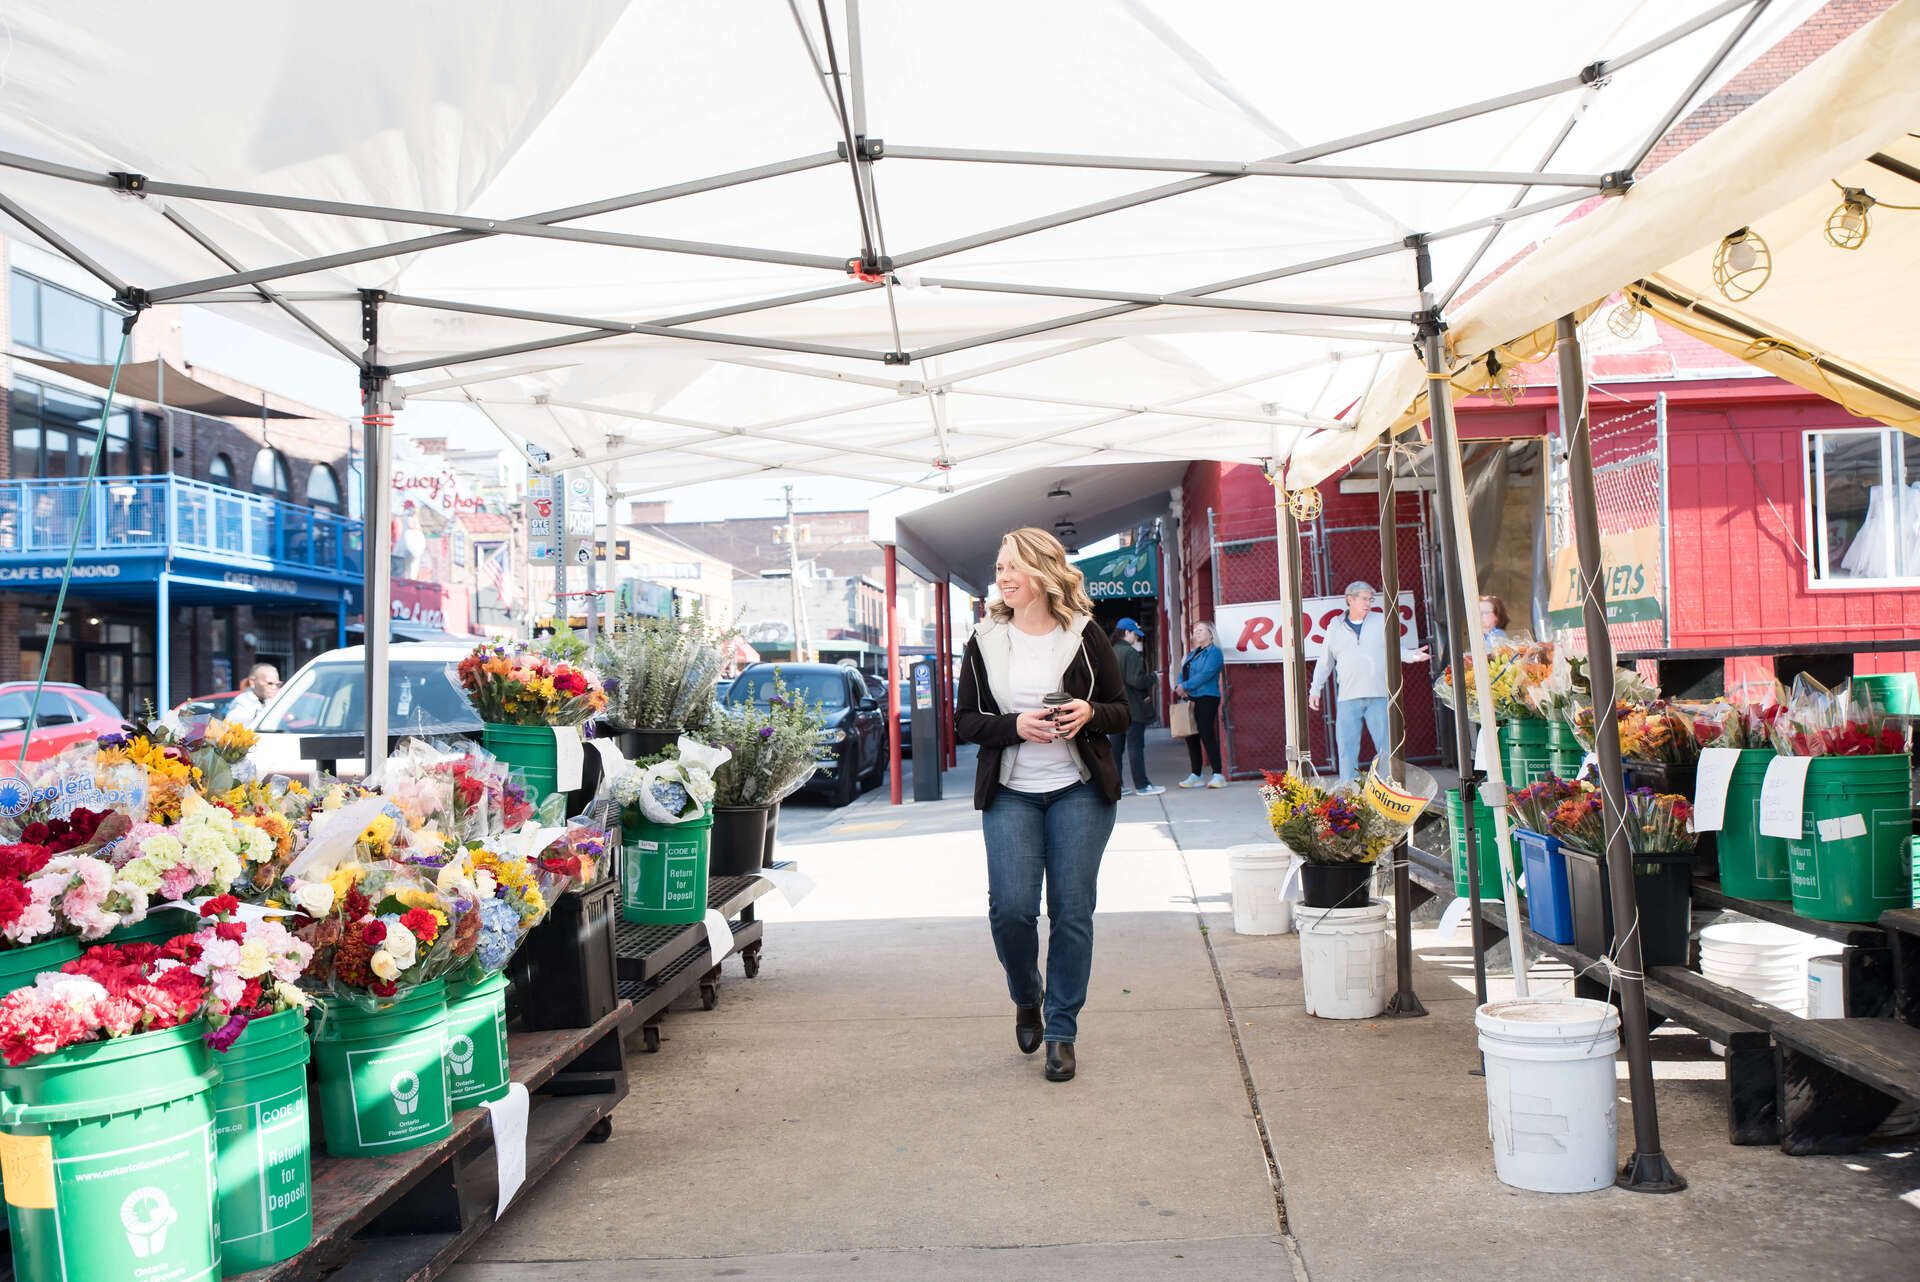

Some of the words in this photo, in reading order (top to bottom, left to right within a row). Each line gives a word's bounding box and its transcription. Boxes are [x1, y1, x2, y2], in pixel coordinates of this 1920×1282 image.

[0, 567, 40, 580] CAFE
[1089, 580, 1127, 596] BROS.
[1132, 580, 1153, 595] CO.
[668, 848, 689, 856] CODE
[670, 869, 693, 878] Return
[677, 881, 687, 889] for
[667, 891, 693, 902] Deposit
[262, 1103, 293, 1124] CODE
[399, 1119, 420, 1128] Ontario
[388, 1128, 408, 1137] Flower
[269, 1143, 301, 1167] Return
[281, 1168, 296, 1184] for
[268, 1182, 305, 1212] Deposit
